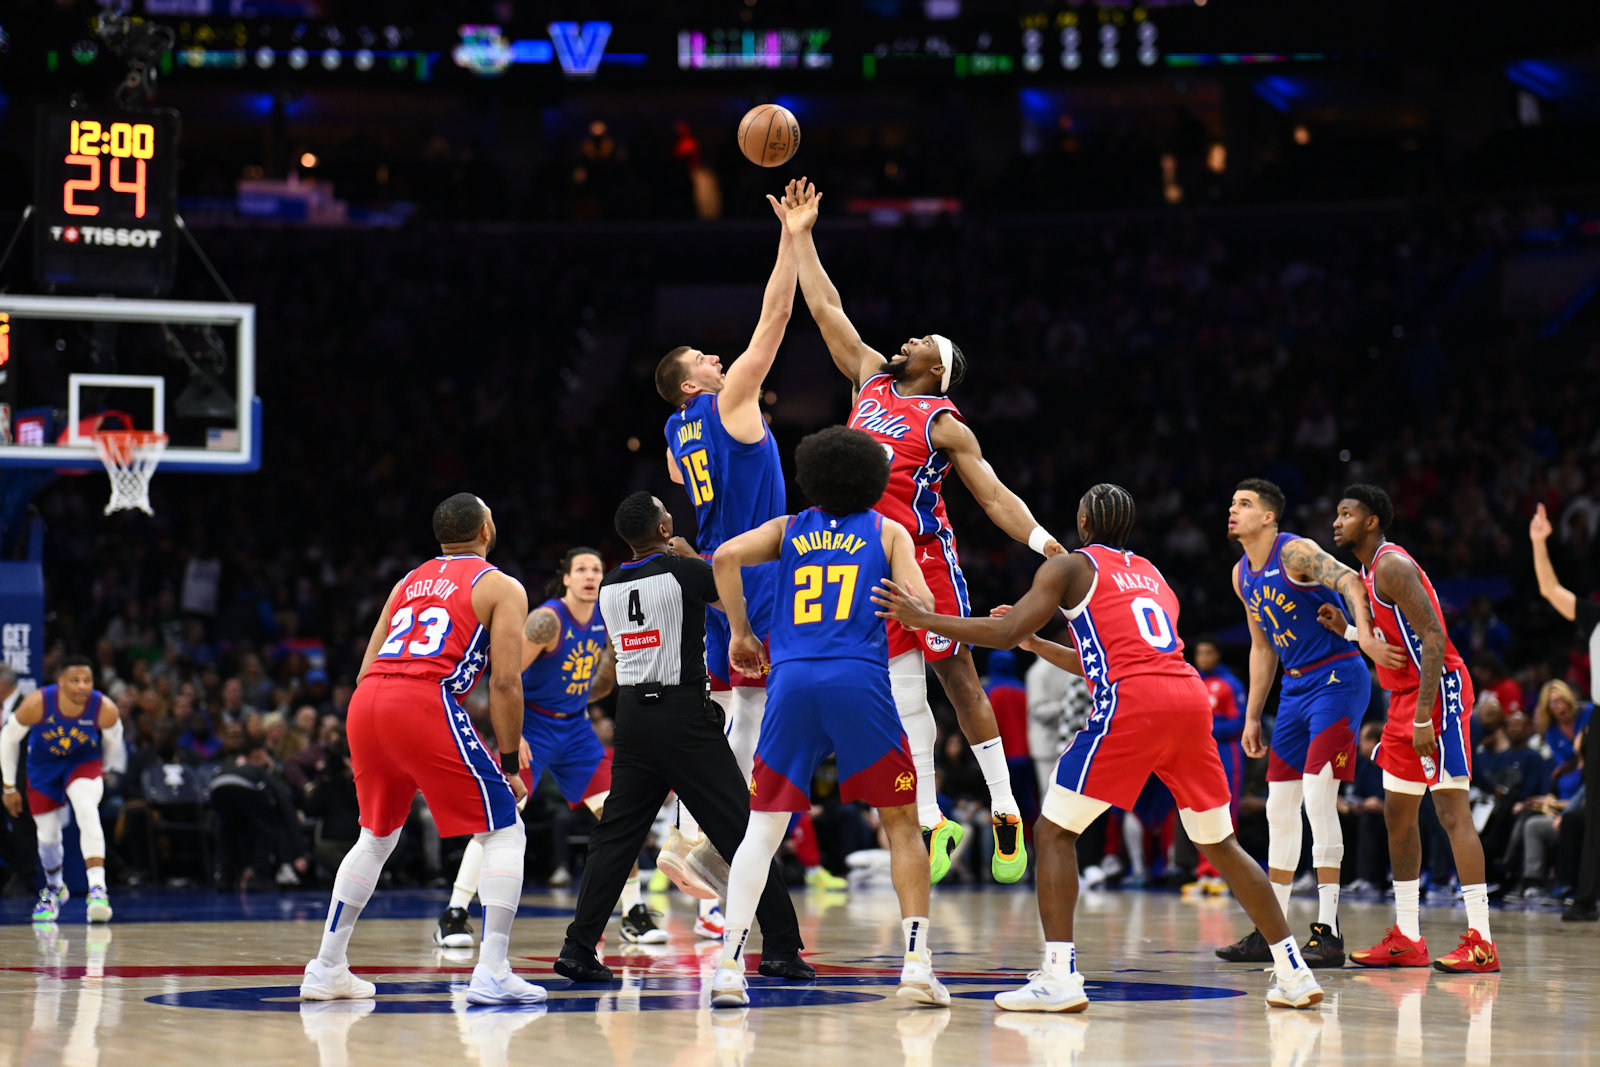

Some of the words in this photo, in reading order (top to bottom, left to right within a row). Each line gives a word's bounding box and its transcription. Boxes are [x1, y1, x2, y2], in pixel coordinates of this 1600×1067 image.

[70, 119, 155, 159] 12:00
[63, 154, 147, 218] 24
[80, 227, 162, 248] TISSOT
[850, 398, 912, 440] Phila
[680, 448, 714, 506] 15
[791, 530, 867, 556] MURRAY
[793, 564, 860, 625] 27
[1111, 572, 1160, 595] MAXEY
[1262, 585, 1297, 613] HIGH
[628, 589, 645, 626] 4
[1263, 605, 1280, 629] 1
[377, 606, 454, 658] 23
[1130, 596, 1178, 653] 0
[1272, 628, 1297, 647] CITY
[624, 635, 658, 647] Emirates
[572, 655, 594, 680] 32
